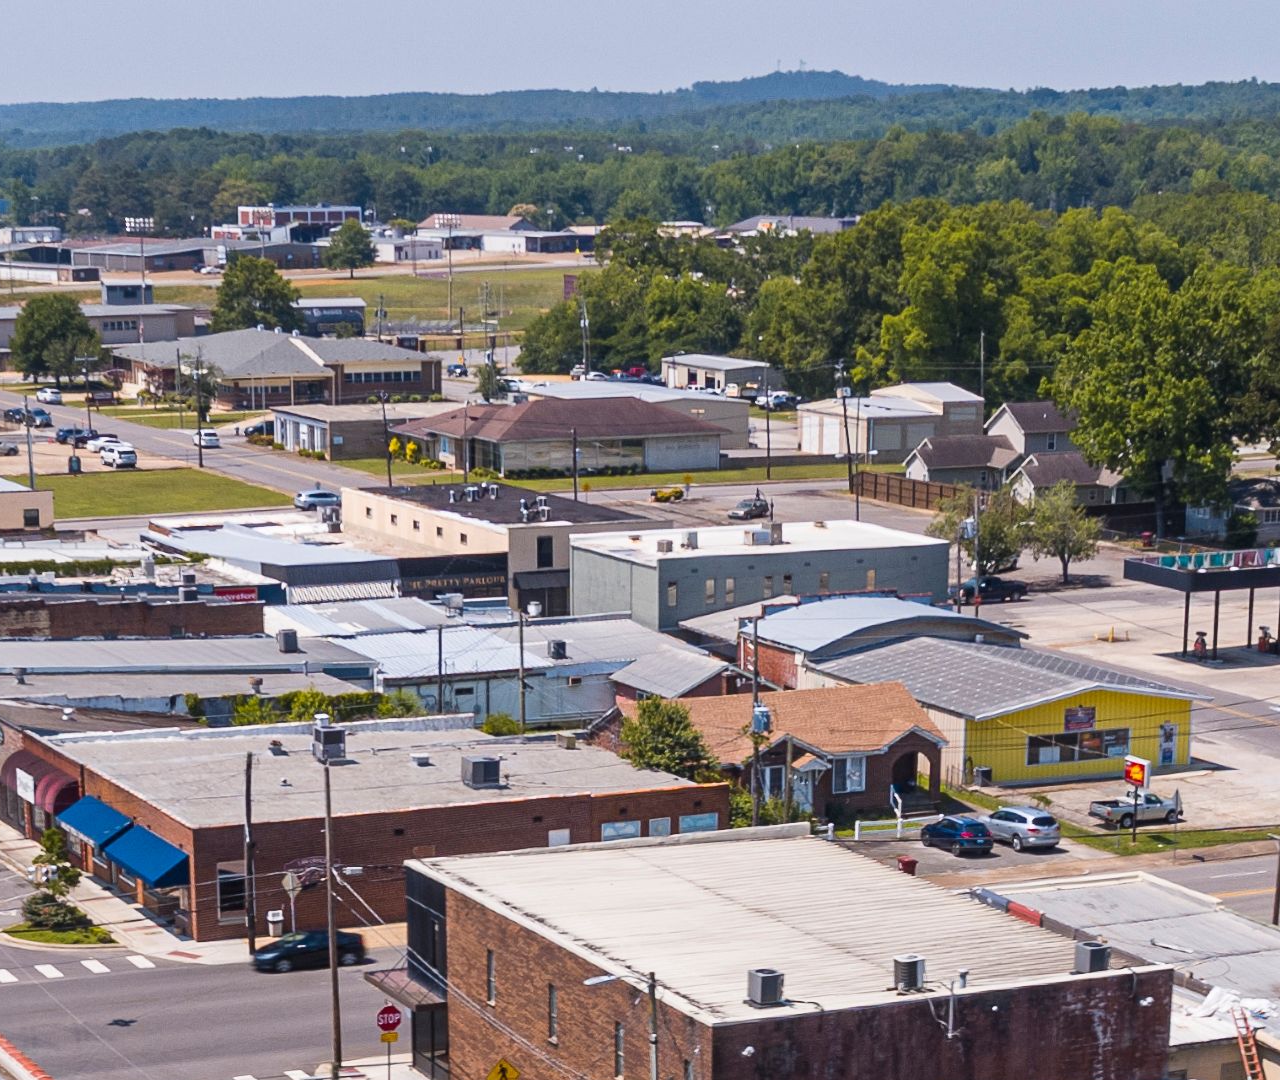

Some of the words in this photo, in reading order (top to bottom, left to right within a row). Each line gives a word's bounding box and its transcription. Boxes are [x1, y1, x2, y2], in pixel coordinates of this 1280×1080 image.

[425, 579, 460, 587] PRETTY
[463, 576, 505, 585] PARLOUR
[378, 1013, 400, 1025] STOP
